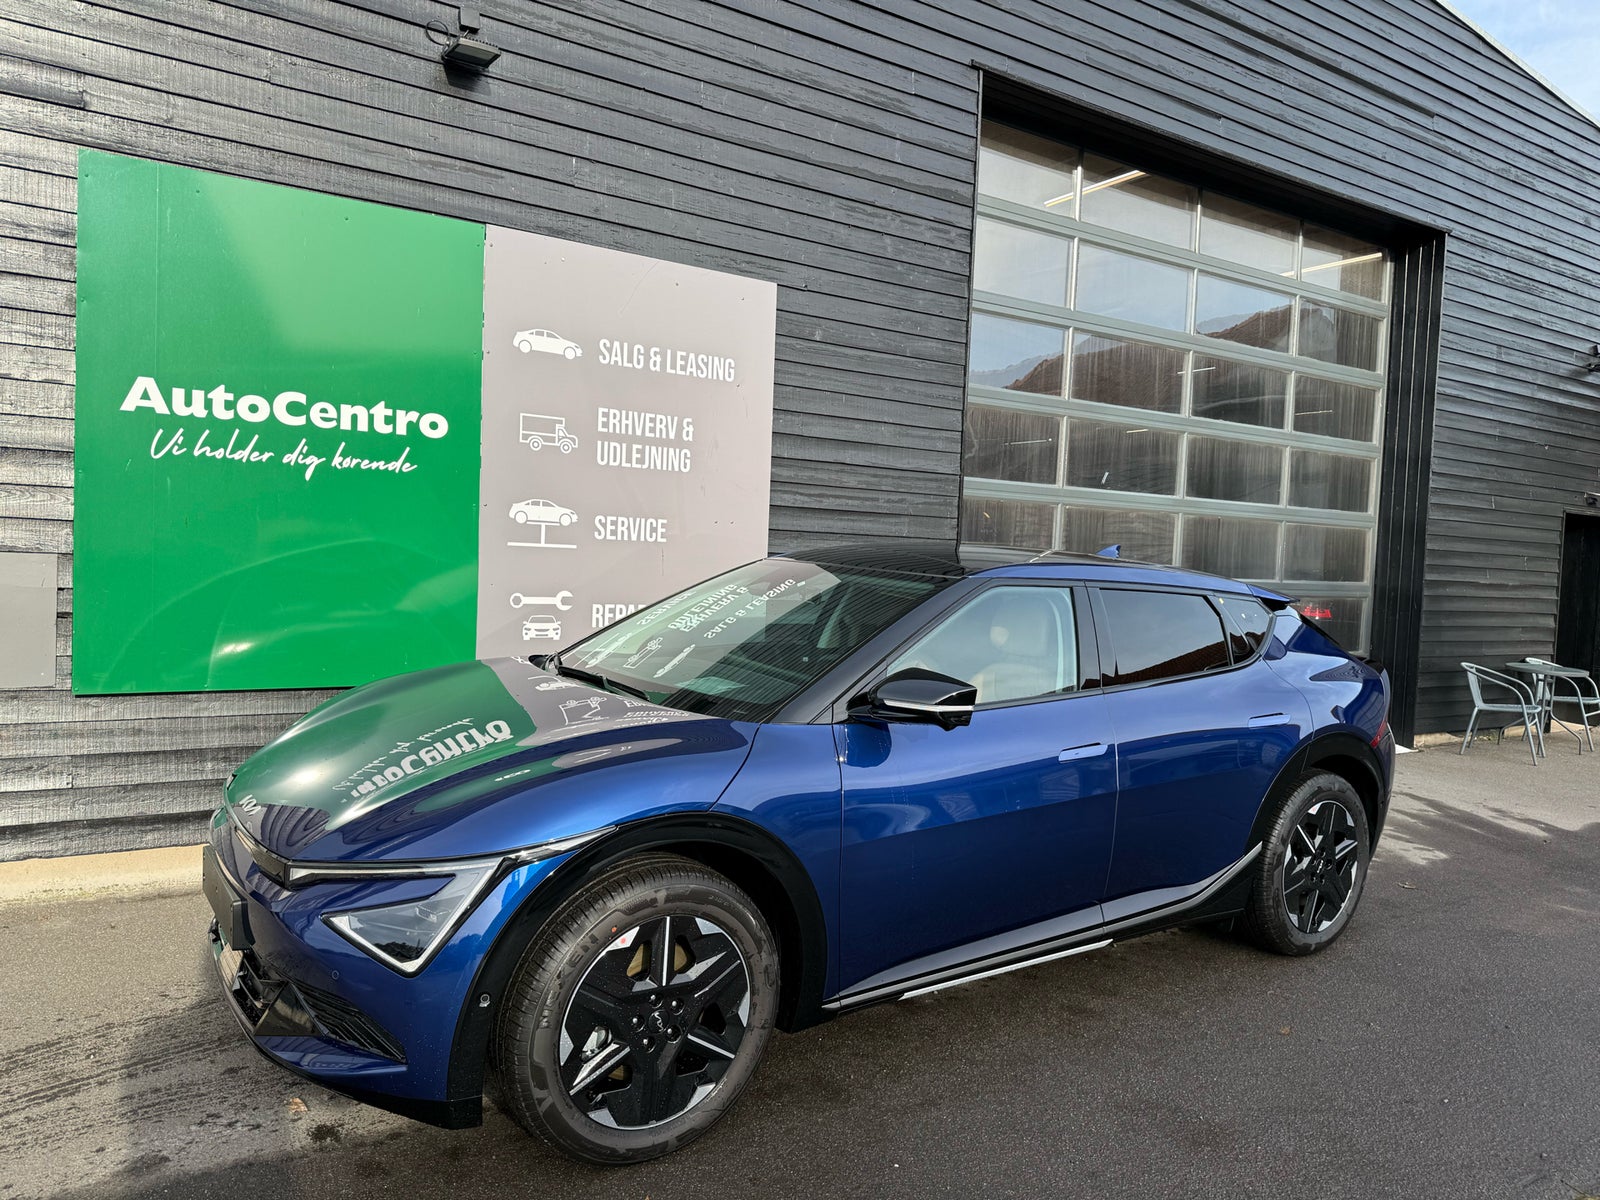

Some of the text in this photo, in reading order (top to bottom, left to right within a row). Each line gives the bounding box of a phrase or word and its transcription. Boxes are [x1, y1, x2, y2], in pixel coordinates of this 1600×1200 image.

[598, 338, 736, 383] SALG & LEASING
[119, 375, 449, 439] AutoCentro
[597, 408, 695, 442] ERHVERV &
[150, 427, 188, 460] Vi
[193, 429, 275, 464] holder
[282, 437, 326, 481] dig
[596, 440, 691, 473] UDLEJNING
[594, 515, 668, 543] SERVICE
